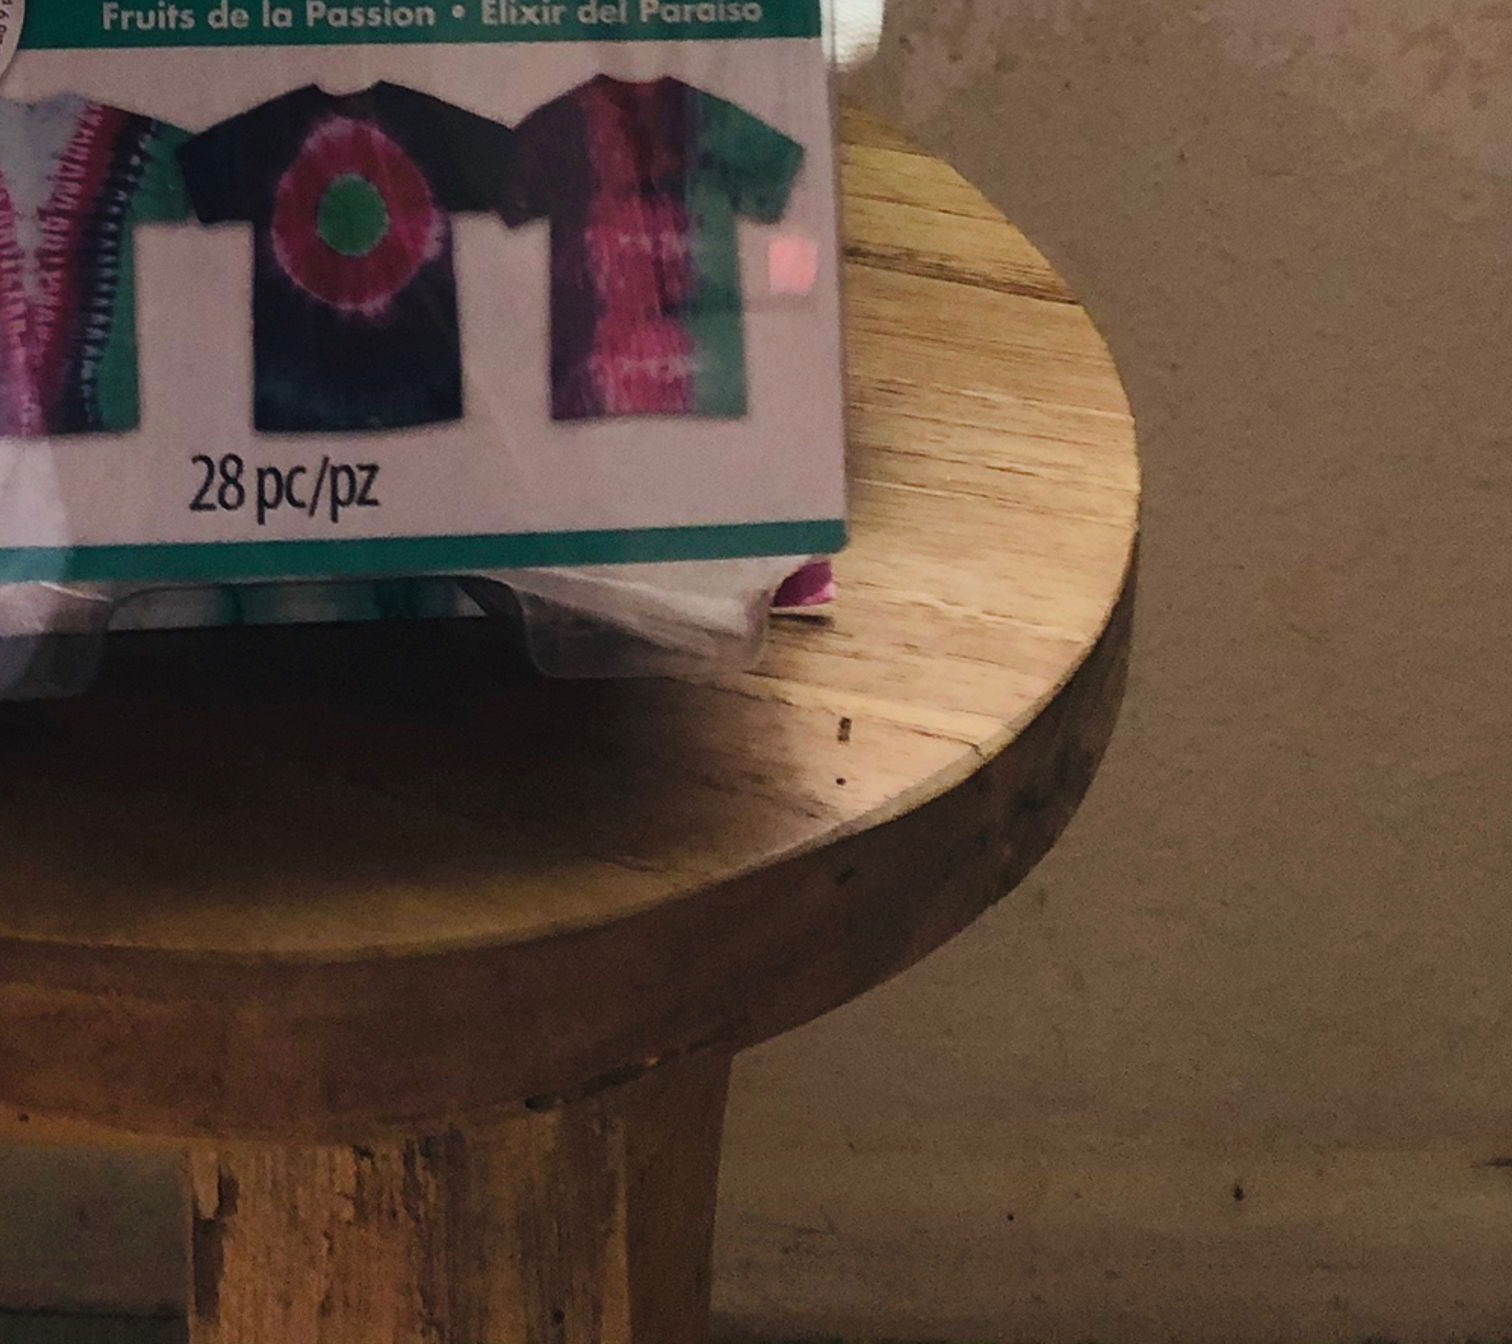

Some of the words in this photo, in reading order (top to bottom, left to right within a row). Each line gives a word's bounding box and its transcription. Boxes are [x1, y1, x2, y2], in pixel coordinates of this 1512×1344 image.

[102, 0, 196, 31] Fruits
[189, 453, 246, 511] 28
[255, 455, 381, 526] pc/pz
